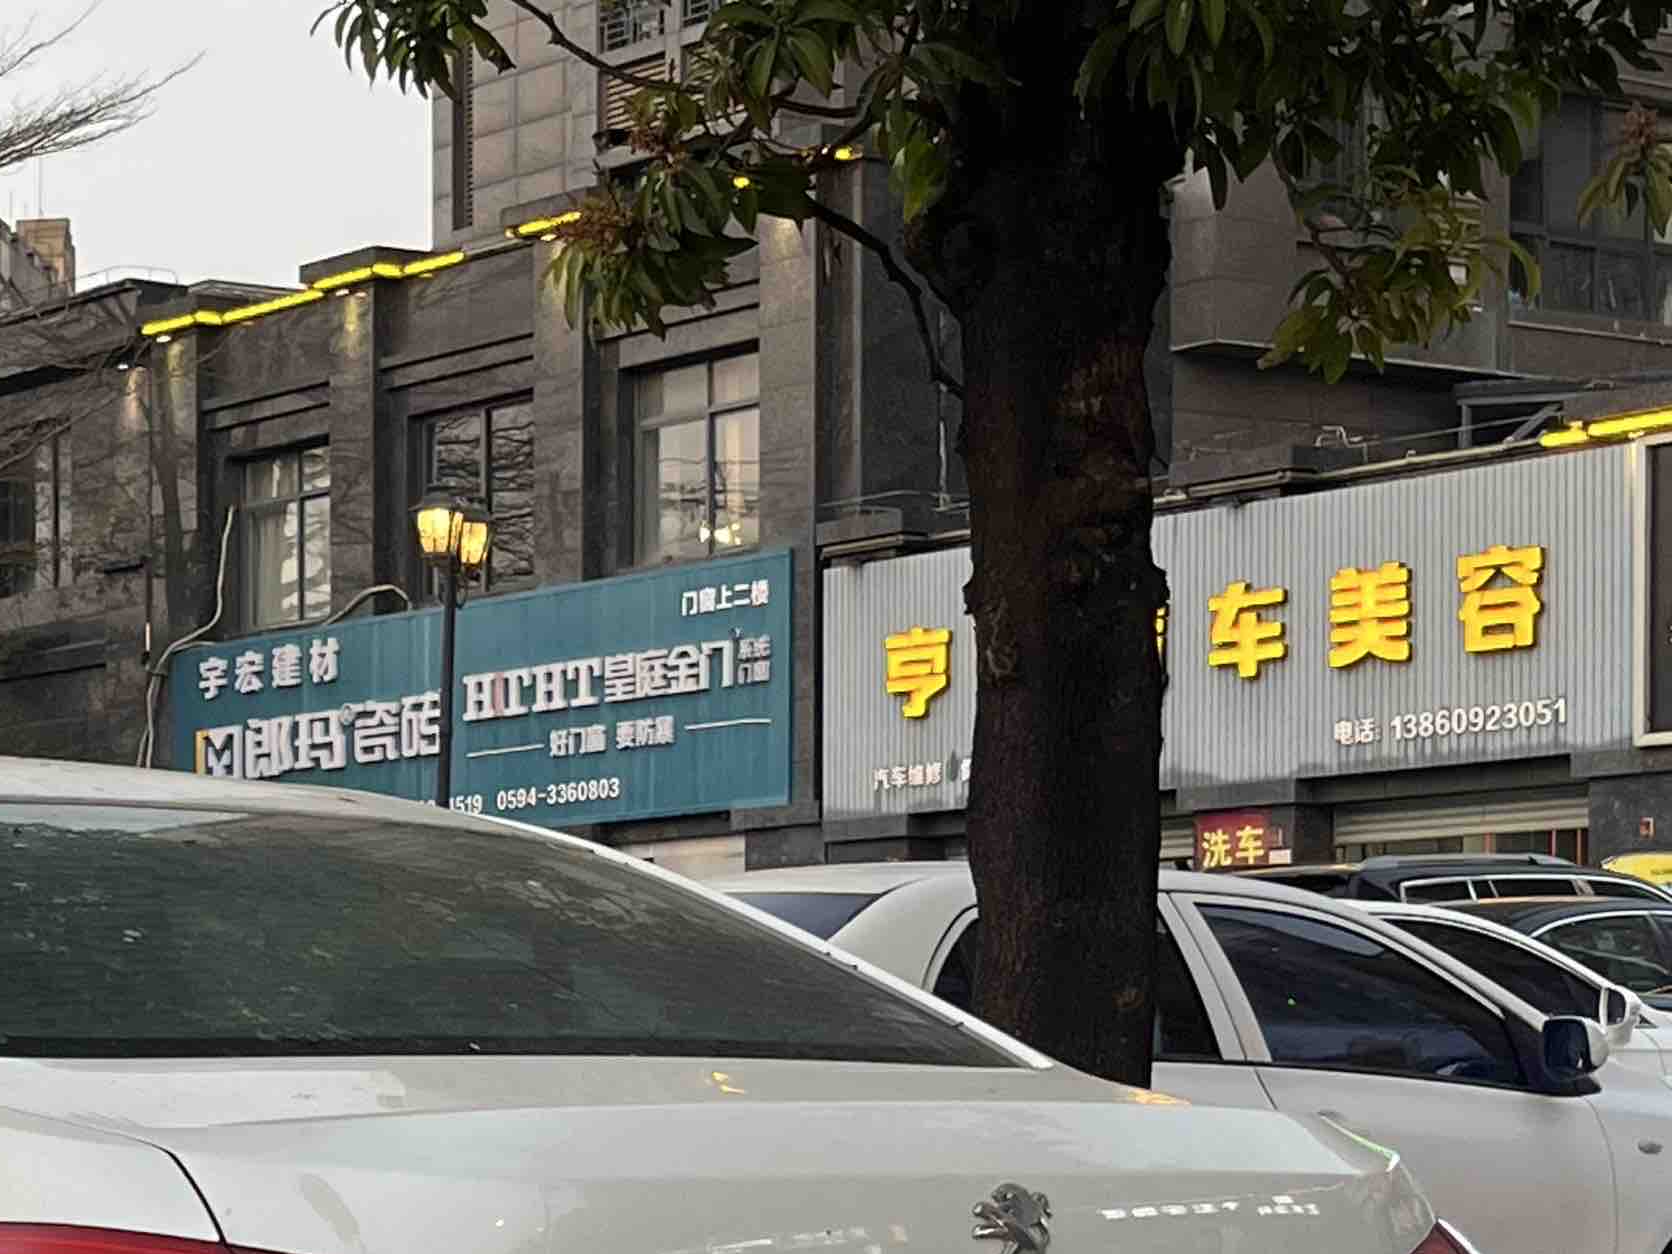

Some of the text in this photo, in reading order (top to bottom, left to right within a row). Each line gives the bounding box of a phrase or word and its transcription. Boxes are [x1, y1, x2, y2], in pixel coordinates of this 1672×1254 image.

[198, 637, 340, 699] 宇宏建材
[1391, 697, 1566, 740] 13860923051
[496, 776, 620, 811] 0594-3360803
[1201, 825, 1265, 867] 洗车
